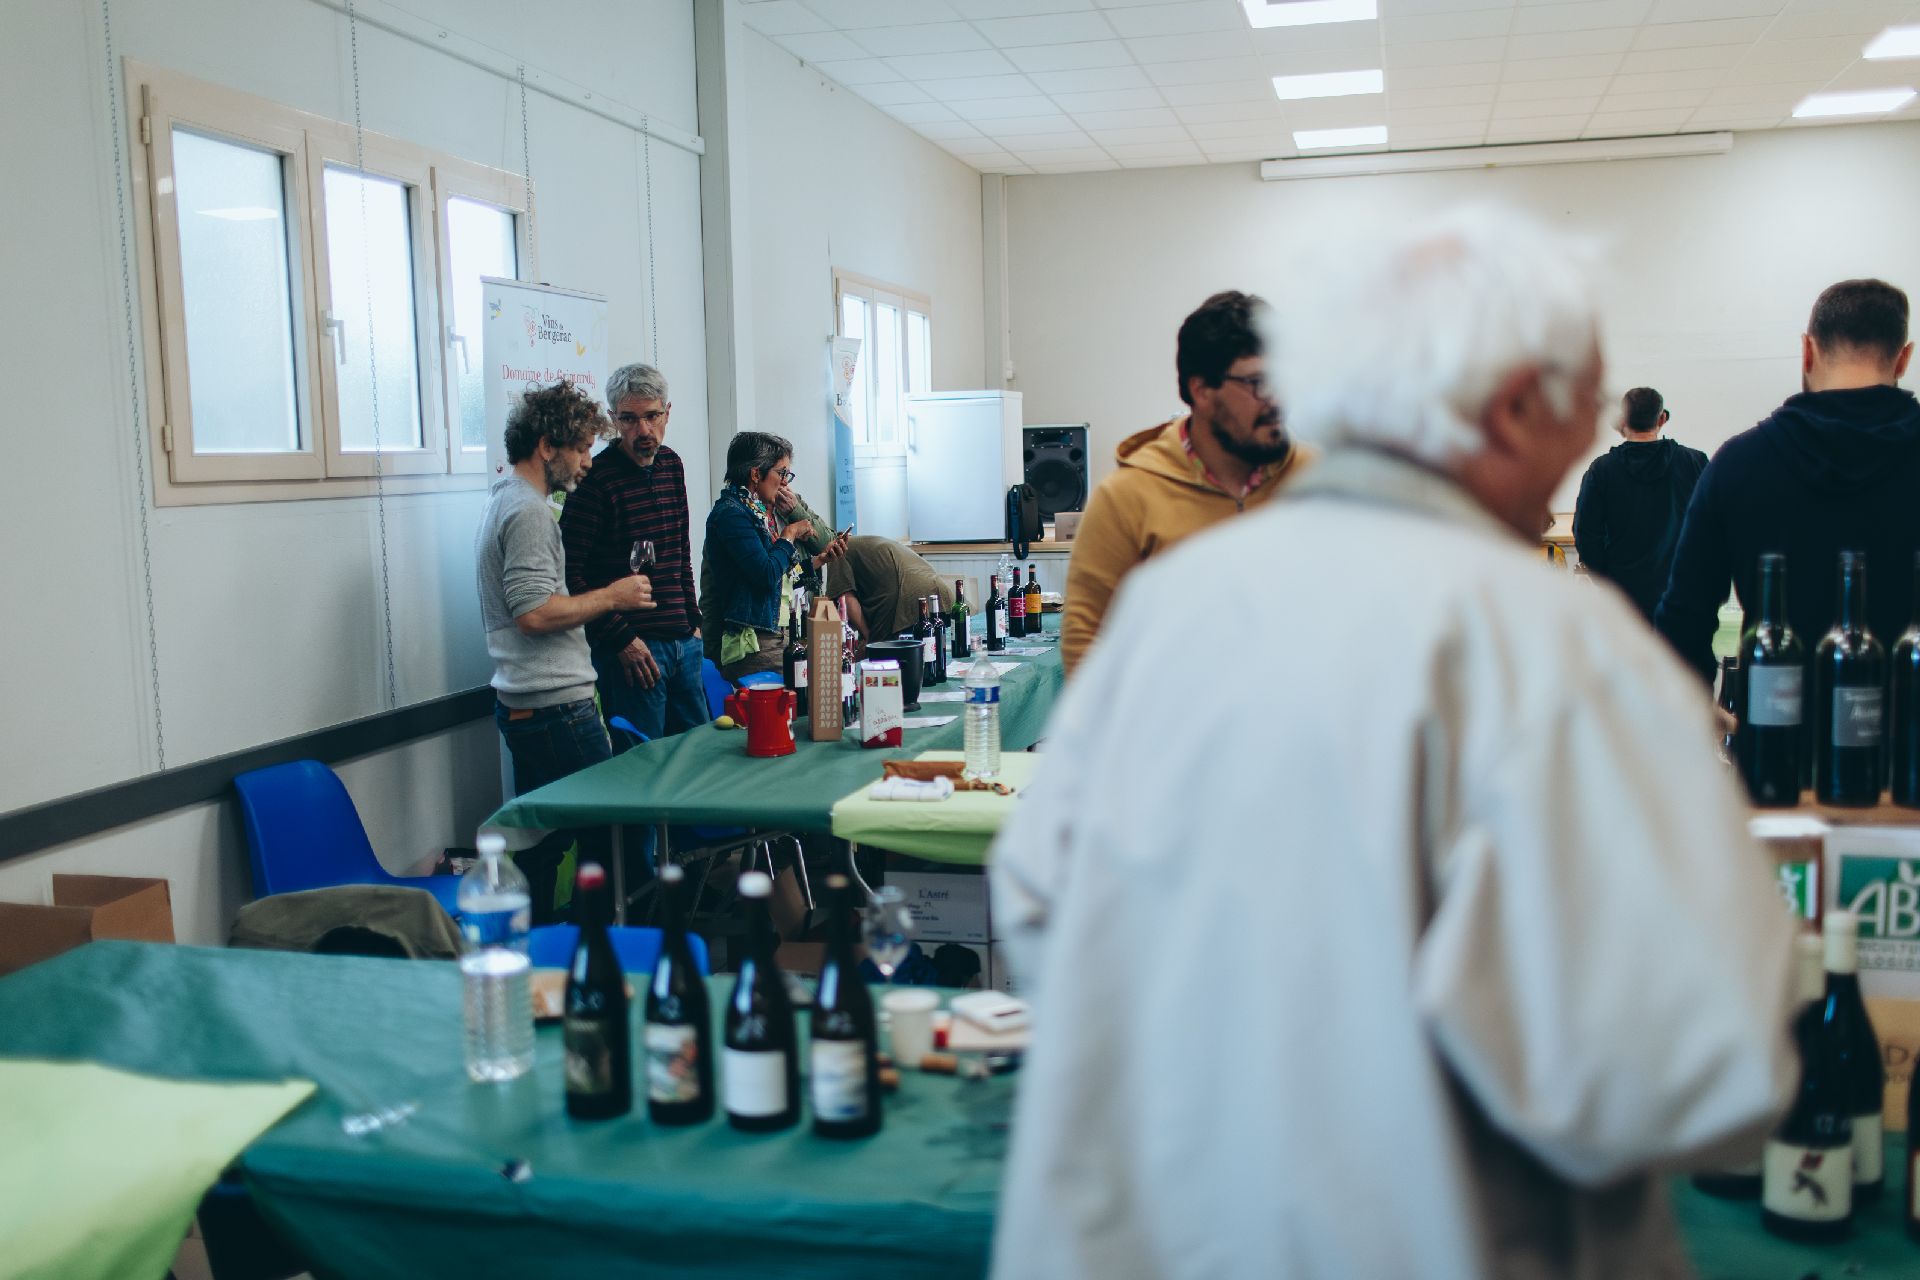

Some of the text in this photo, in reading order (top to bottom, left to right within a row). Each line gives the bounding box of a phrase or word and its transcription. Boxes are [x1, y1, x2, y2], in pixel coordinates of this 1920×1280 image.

[541, 314, 559, 329] Vins
[538, 325, 572, 344] Bergerac
[502, 364, 541, 381] Domaine
[544, 367, 554, 383] de
[1846, 878, 1920, 937] AB
